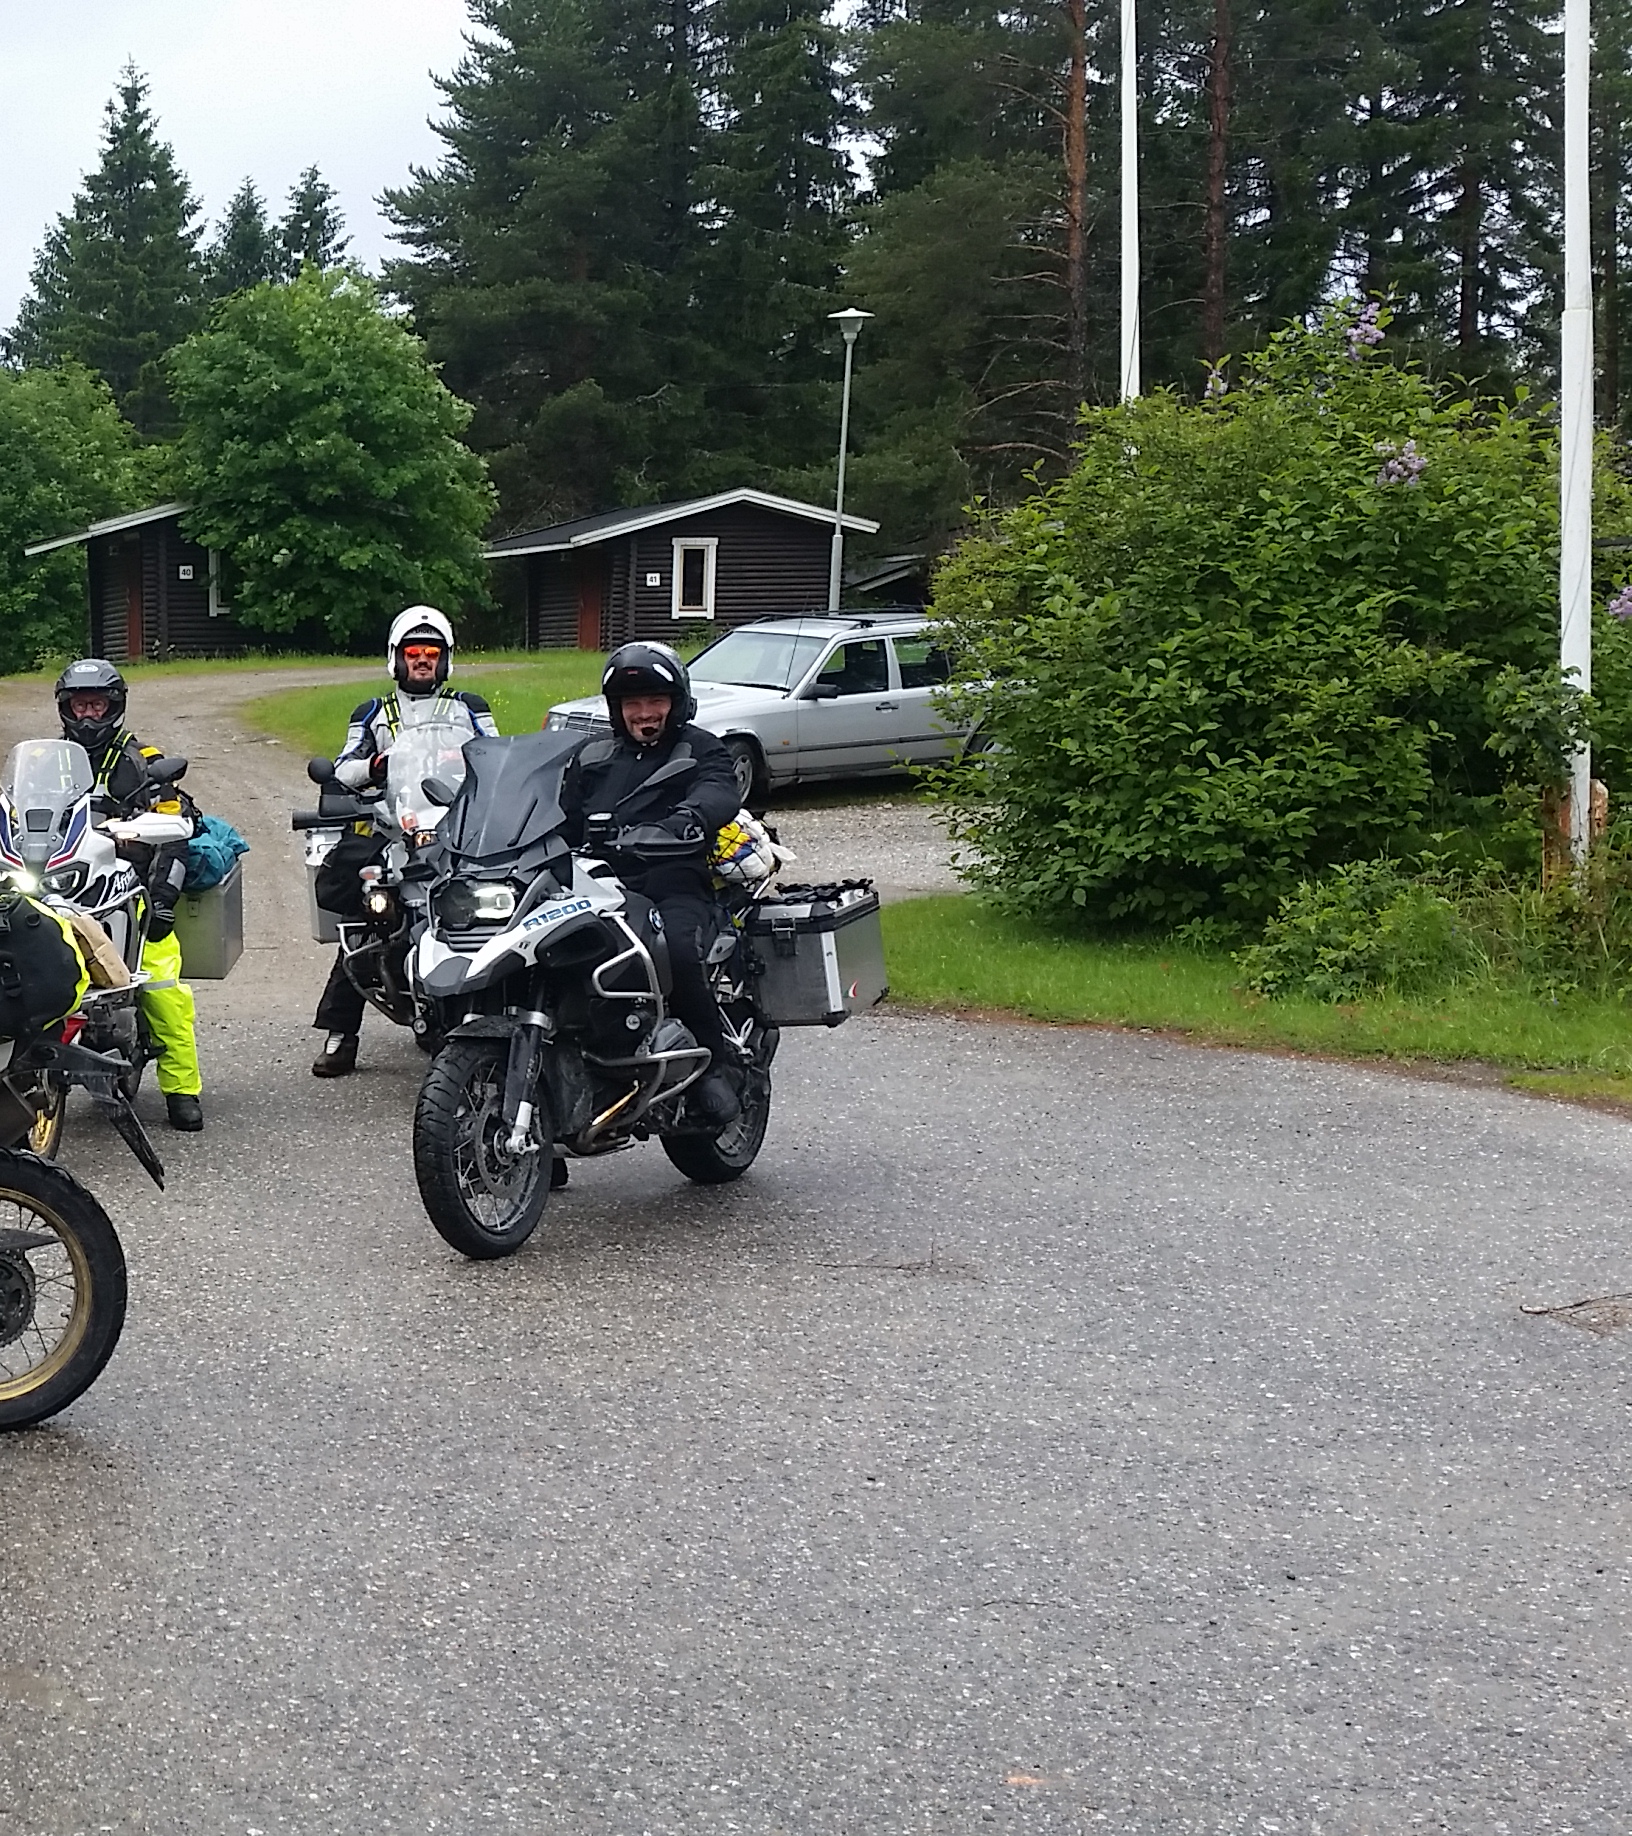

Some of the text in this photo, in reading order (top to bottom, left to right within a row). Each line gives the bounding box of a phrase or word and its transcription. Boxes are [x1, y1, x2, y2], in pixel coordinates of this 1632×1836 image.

[181, 568, 192, 577] 40
[649, 575, 657, 583] 41
[522, 899, 592, 932] R1200
